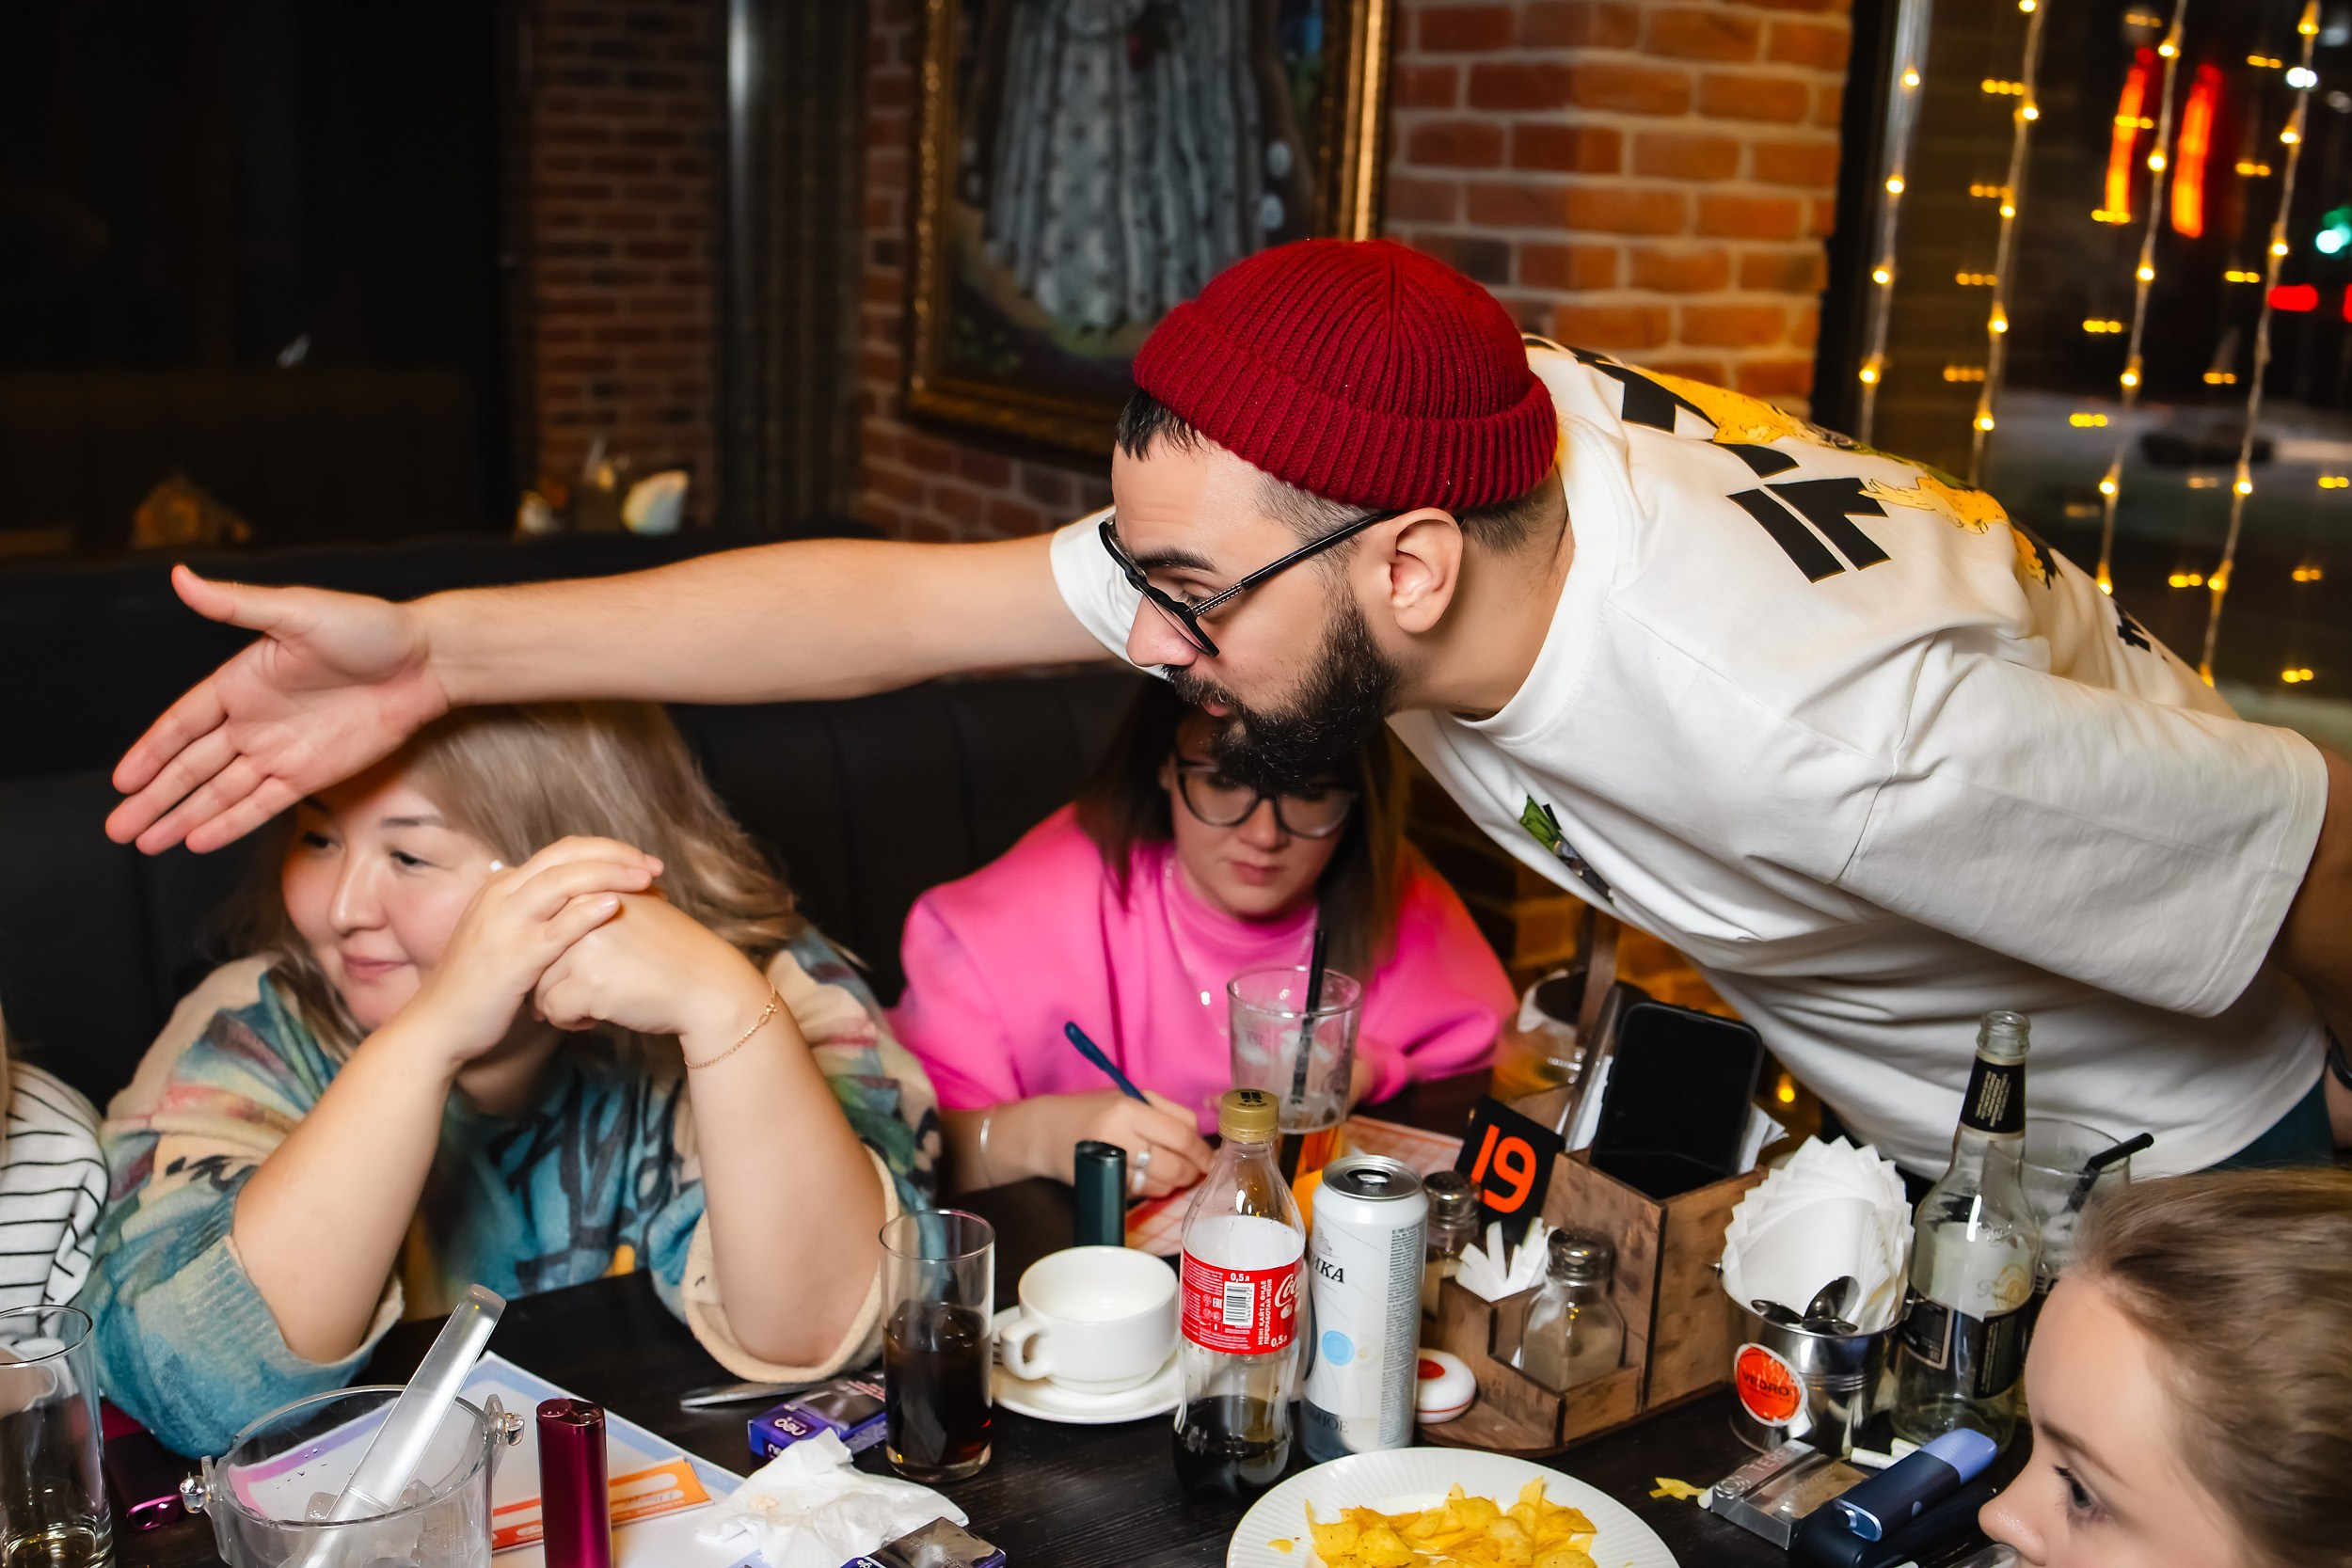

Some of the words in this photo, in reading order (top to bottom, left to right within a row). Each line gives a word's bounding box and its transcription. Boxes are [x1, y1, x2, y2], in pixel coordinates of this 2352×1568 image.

[1470, 1124, 1537, 1214] 19
[1742, 1370, 1789, 1396] VEDRO
[774, 1418, 807, 1436] neo
